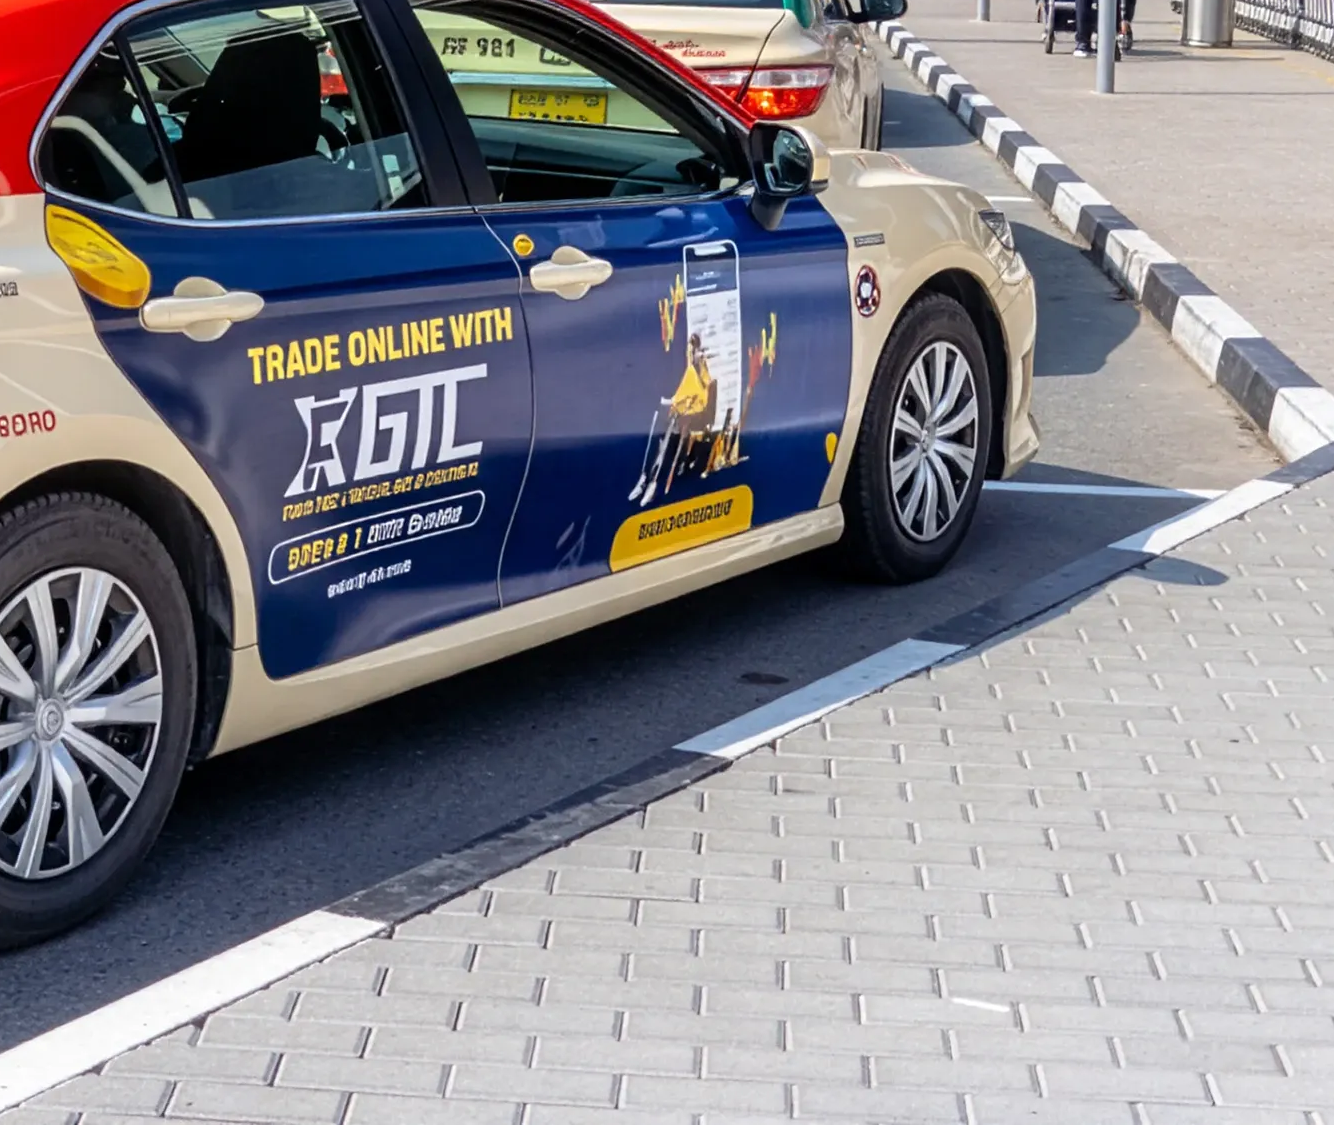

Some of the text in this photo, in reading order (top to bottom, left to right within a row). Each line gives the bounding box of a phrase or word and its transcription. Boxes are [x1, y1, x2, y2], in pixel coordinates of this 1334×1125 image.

[247, 307, 513, 384] TRADE ONLINE WITH
